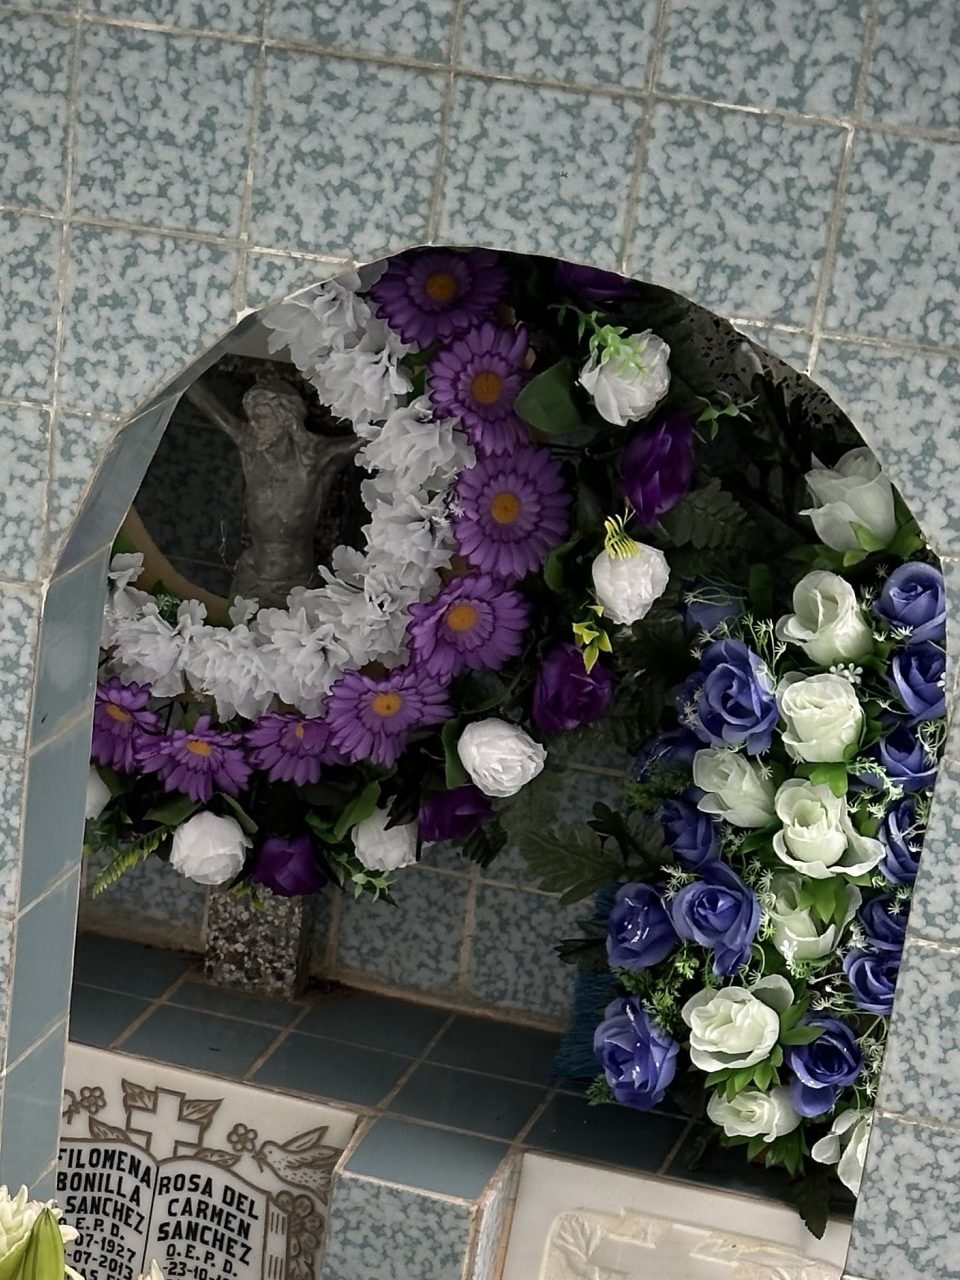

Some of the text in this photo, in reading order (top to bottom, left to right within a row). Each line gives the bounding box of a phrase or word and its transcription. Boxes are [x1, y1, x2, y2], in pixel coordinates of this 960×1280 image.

[56, 1171, 140, 1207] BONILLA
[58, 1147, 151, 1189] FILOMENA
[65, 1195, 146, 1235] SANCHEZ
[157, 1173, 258, 1220] ROSA DEL
[167, 1197, 251, 1240] CARMEN
[157, 1220, 252, 1266] SANCHEZ
[63, 1249, 134, 1280] -07-2013
